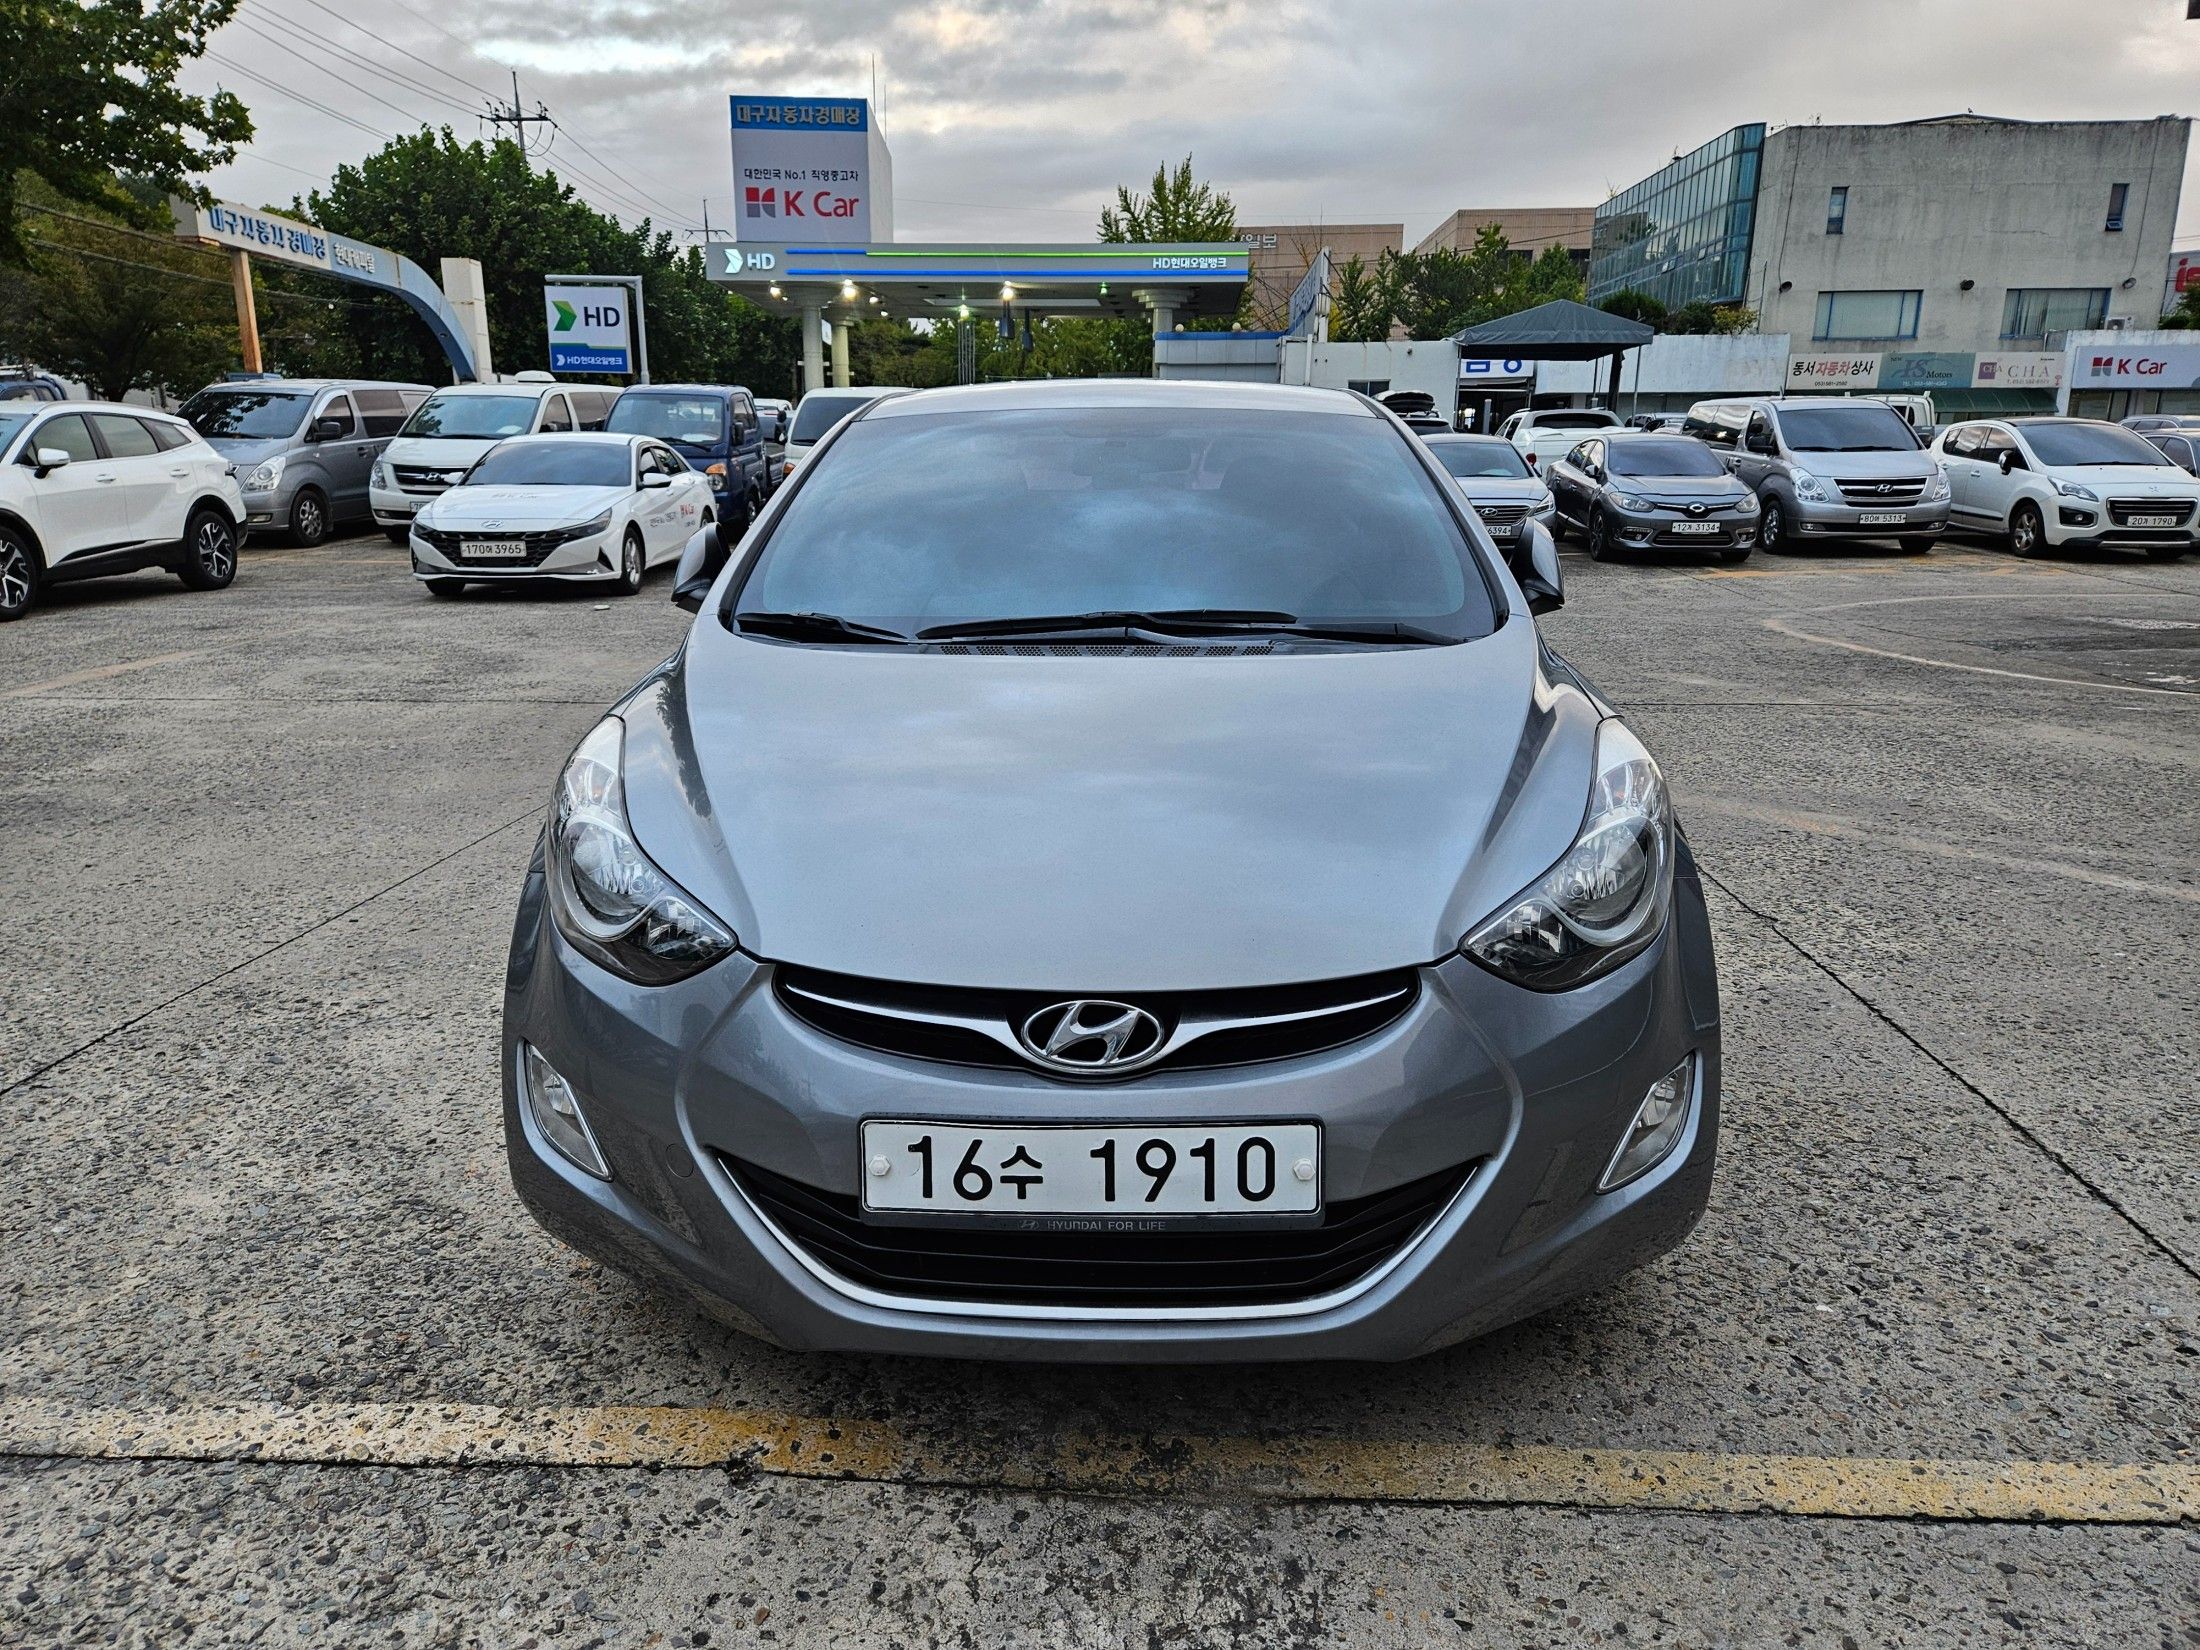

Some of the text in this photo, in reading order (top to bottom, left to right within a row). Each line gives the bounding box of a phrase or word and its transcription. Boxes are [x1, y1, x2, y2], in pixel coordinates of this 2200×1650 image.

[744, 168, 859, 181] 대한민국 No.1 직영중고차
[784, 190, 860, 218] K Car
[747, 252, 776, 270] HD
[1152, 257, 1228, 269] HD현대오일뱅크
[583, 306, 620, 327] HD
[2117, 358, 2168, 375] K Car
[1926, 370, 1953, 379] Motors
[1695, 523, 1716, 532] 3134
[2152, 517, 2174, 526] 1790
[1487, 526, 1508, 535] 6394
[907, 1135, 1276, 1202] 16수 1910
[1108, 1221, 1134, 1231] FOR
[1138, 1221, 1167, 1231] LIFE
